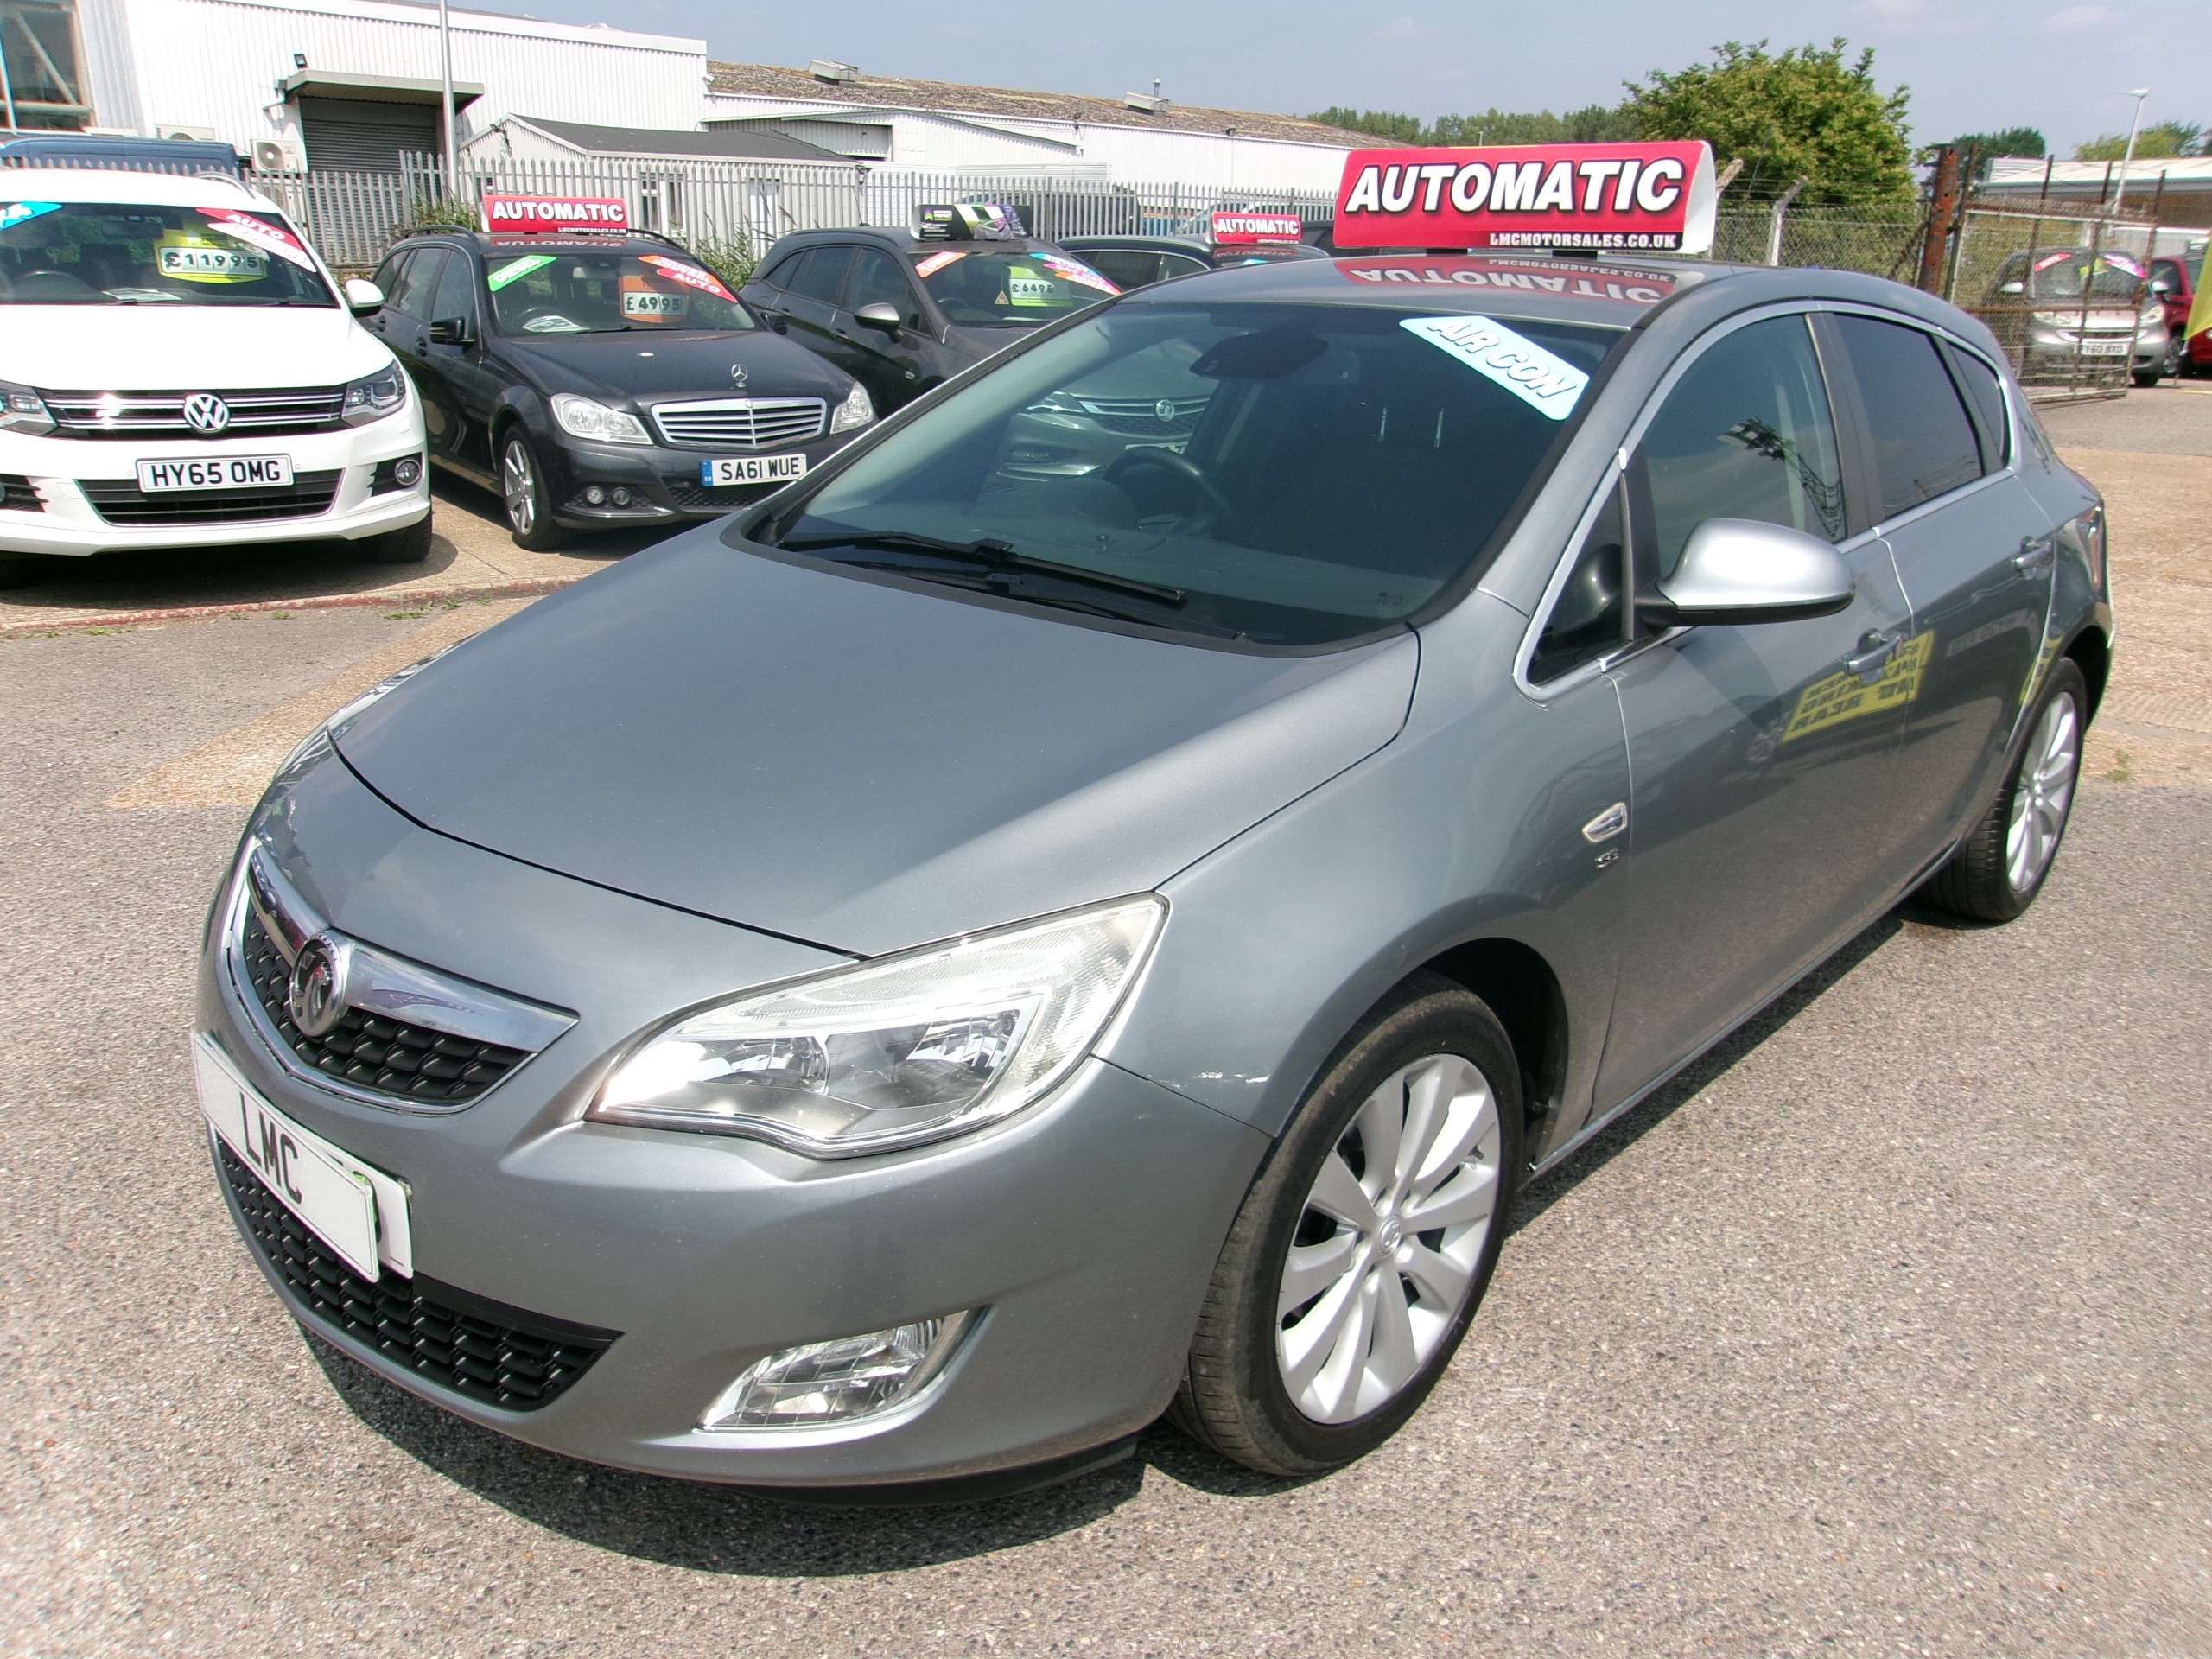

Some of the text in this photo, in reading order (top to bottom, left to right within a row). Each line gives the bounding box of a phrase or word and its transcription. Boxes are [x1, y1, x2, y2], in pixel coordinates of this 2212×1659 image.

[1345, 158, 1684, 213] AUTOMATIC
[492, 200, 626, 222] AUTOMATIC
[226, 213, 286, 240] AUTO
[1217, 218, 1300, 235] AUTOMATIC
[1489, 232, 1677, 249] LMCMOTORSALES.CO.UK
[164, 251, 259, 269] £11995
[673, 272, 721, 294] AUTO
[1428, 319, 1580, 399] AIR CON
[150, 458, 280, 486] HY65 OMG
[721, 457, 800, 480] SA61 WUE
[240, 1091, 303, 1205] LMC
